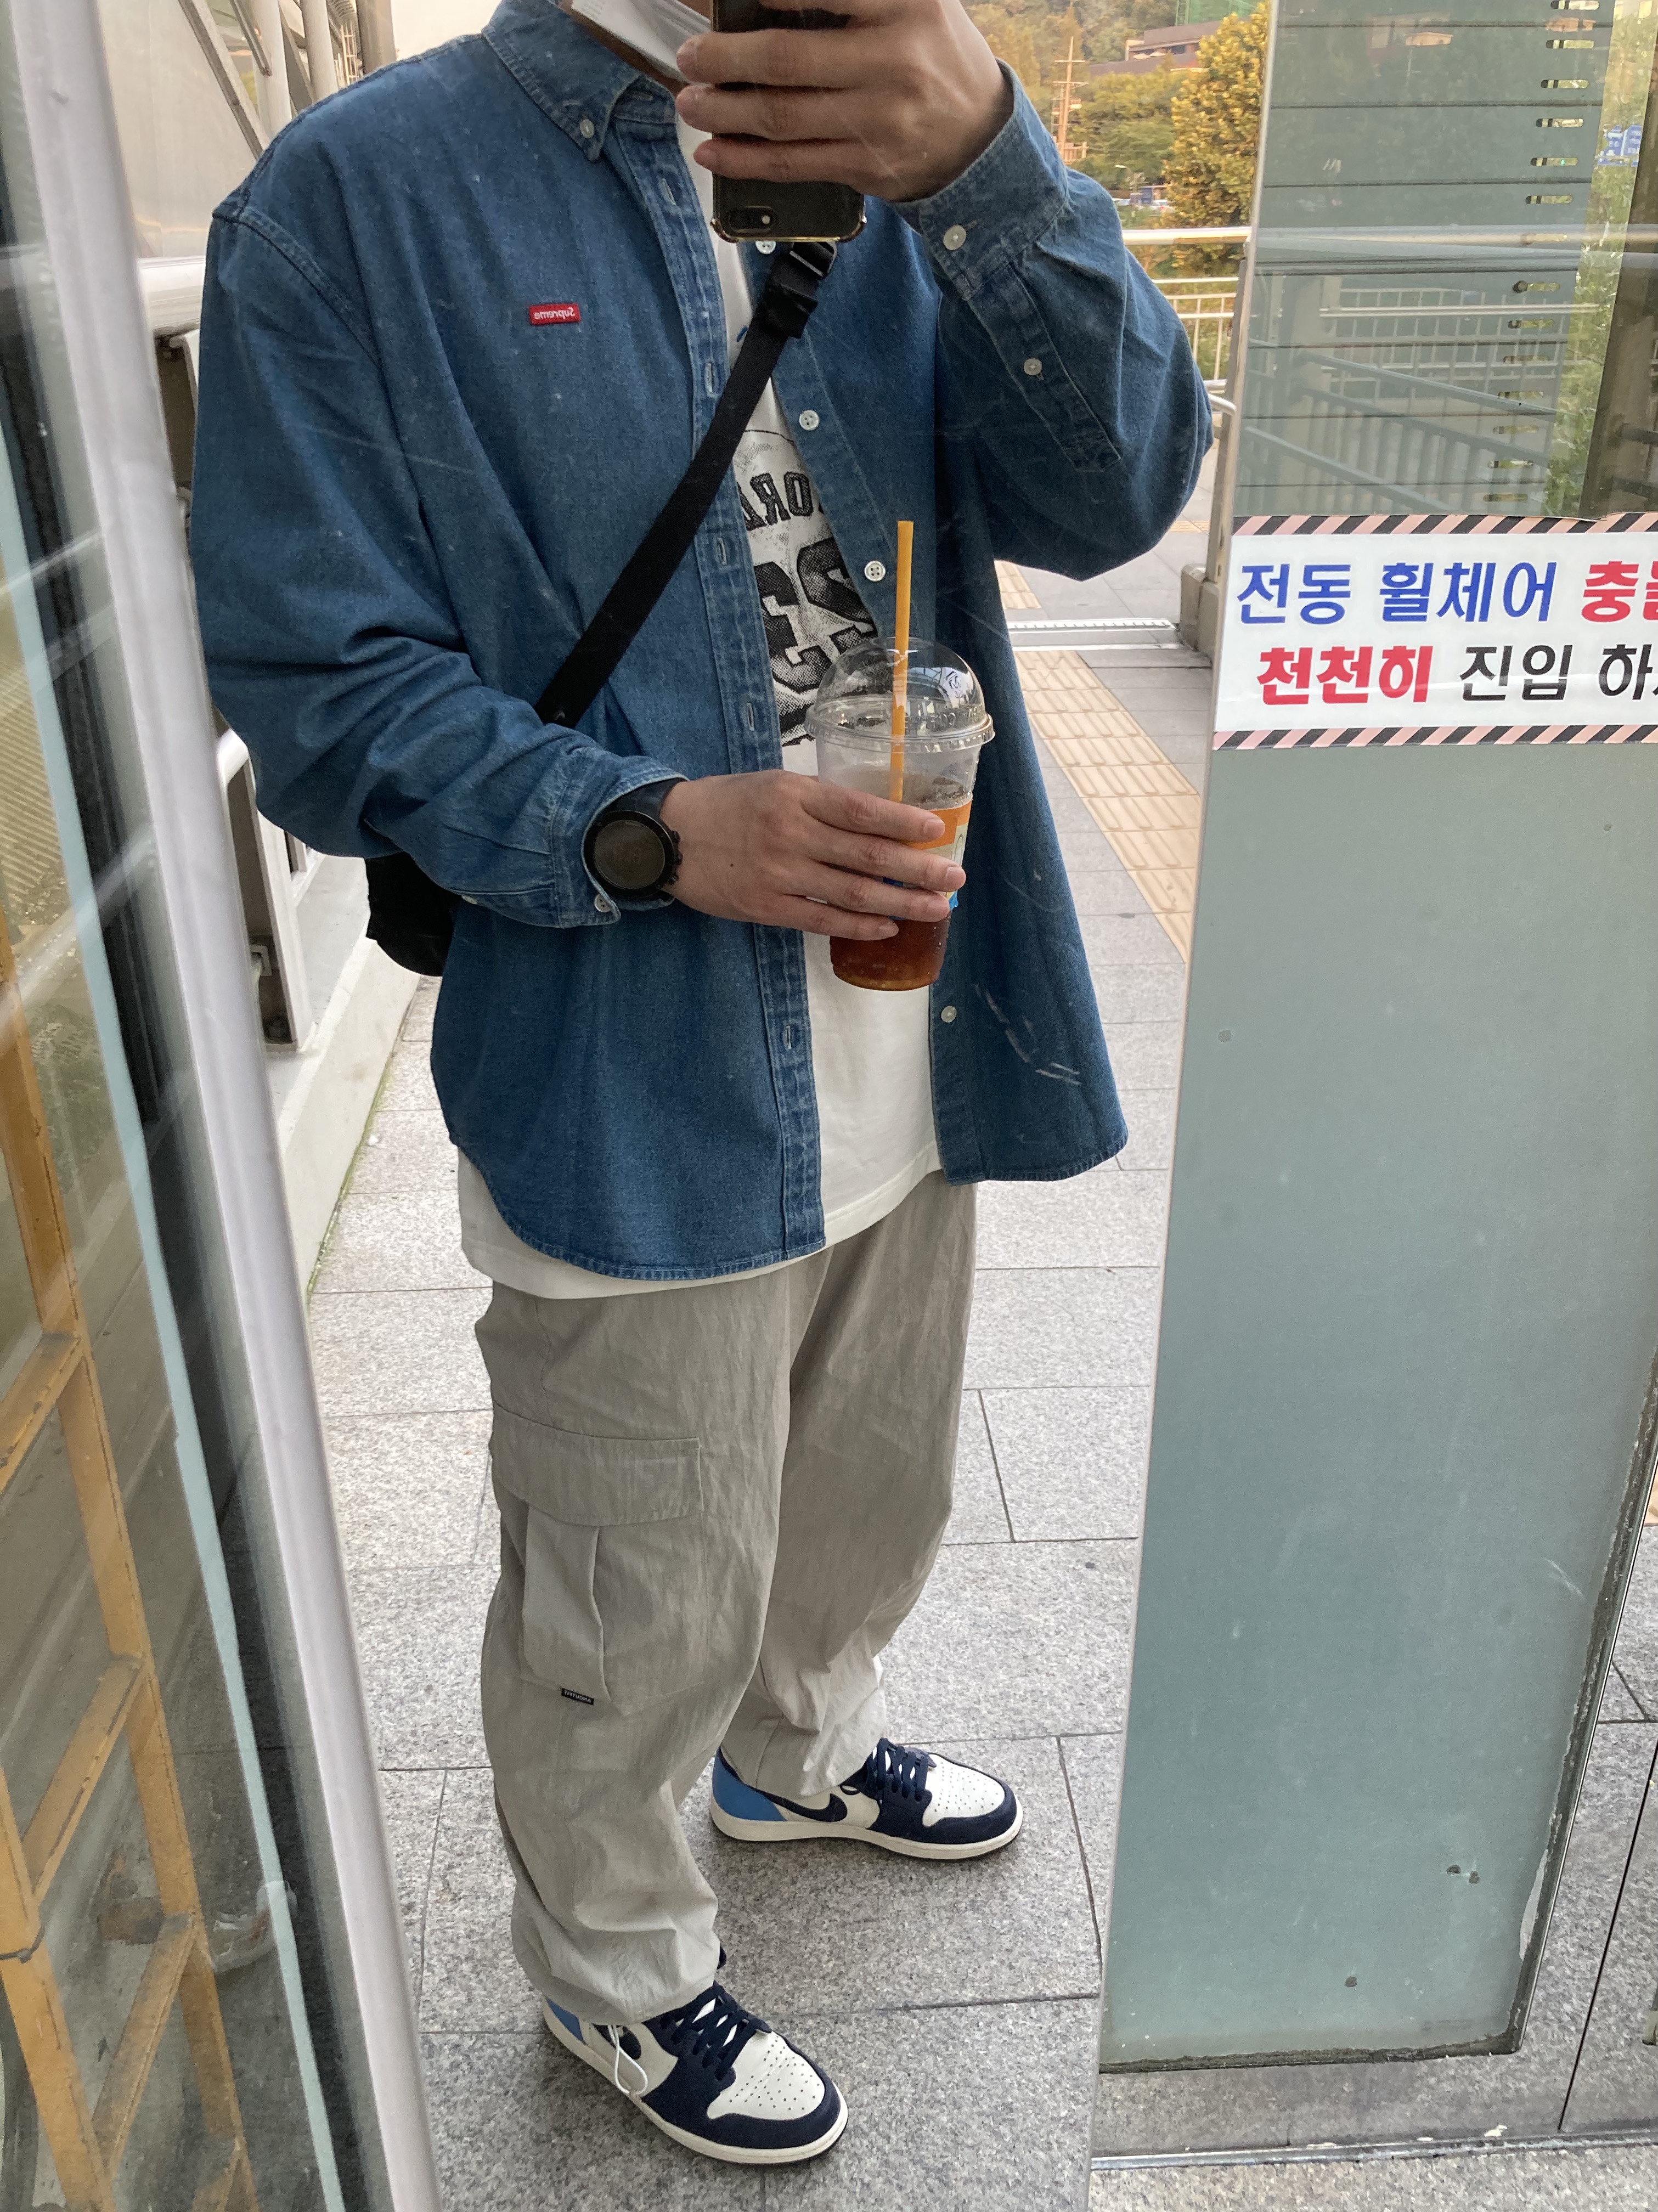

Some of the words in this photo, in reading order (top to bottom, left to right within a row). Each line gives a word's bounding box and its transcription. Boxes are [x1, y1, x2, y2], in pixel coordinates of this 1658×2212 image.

[1237, 563, 1352, 625] 전동
[1378, 561, 1558, 623] 휠체어
[1581, 561, 1658, 623] 충
[1256, 645, 1434, 706] 천천히
[1459, 645, 1574, 701] 진입
[1599, 644, 1658, 701] 하
